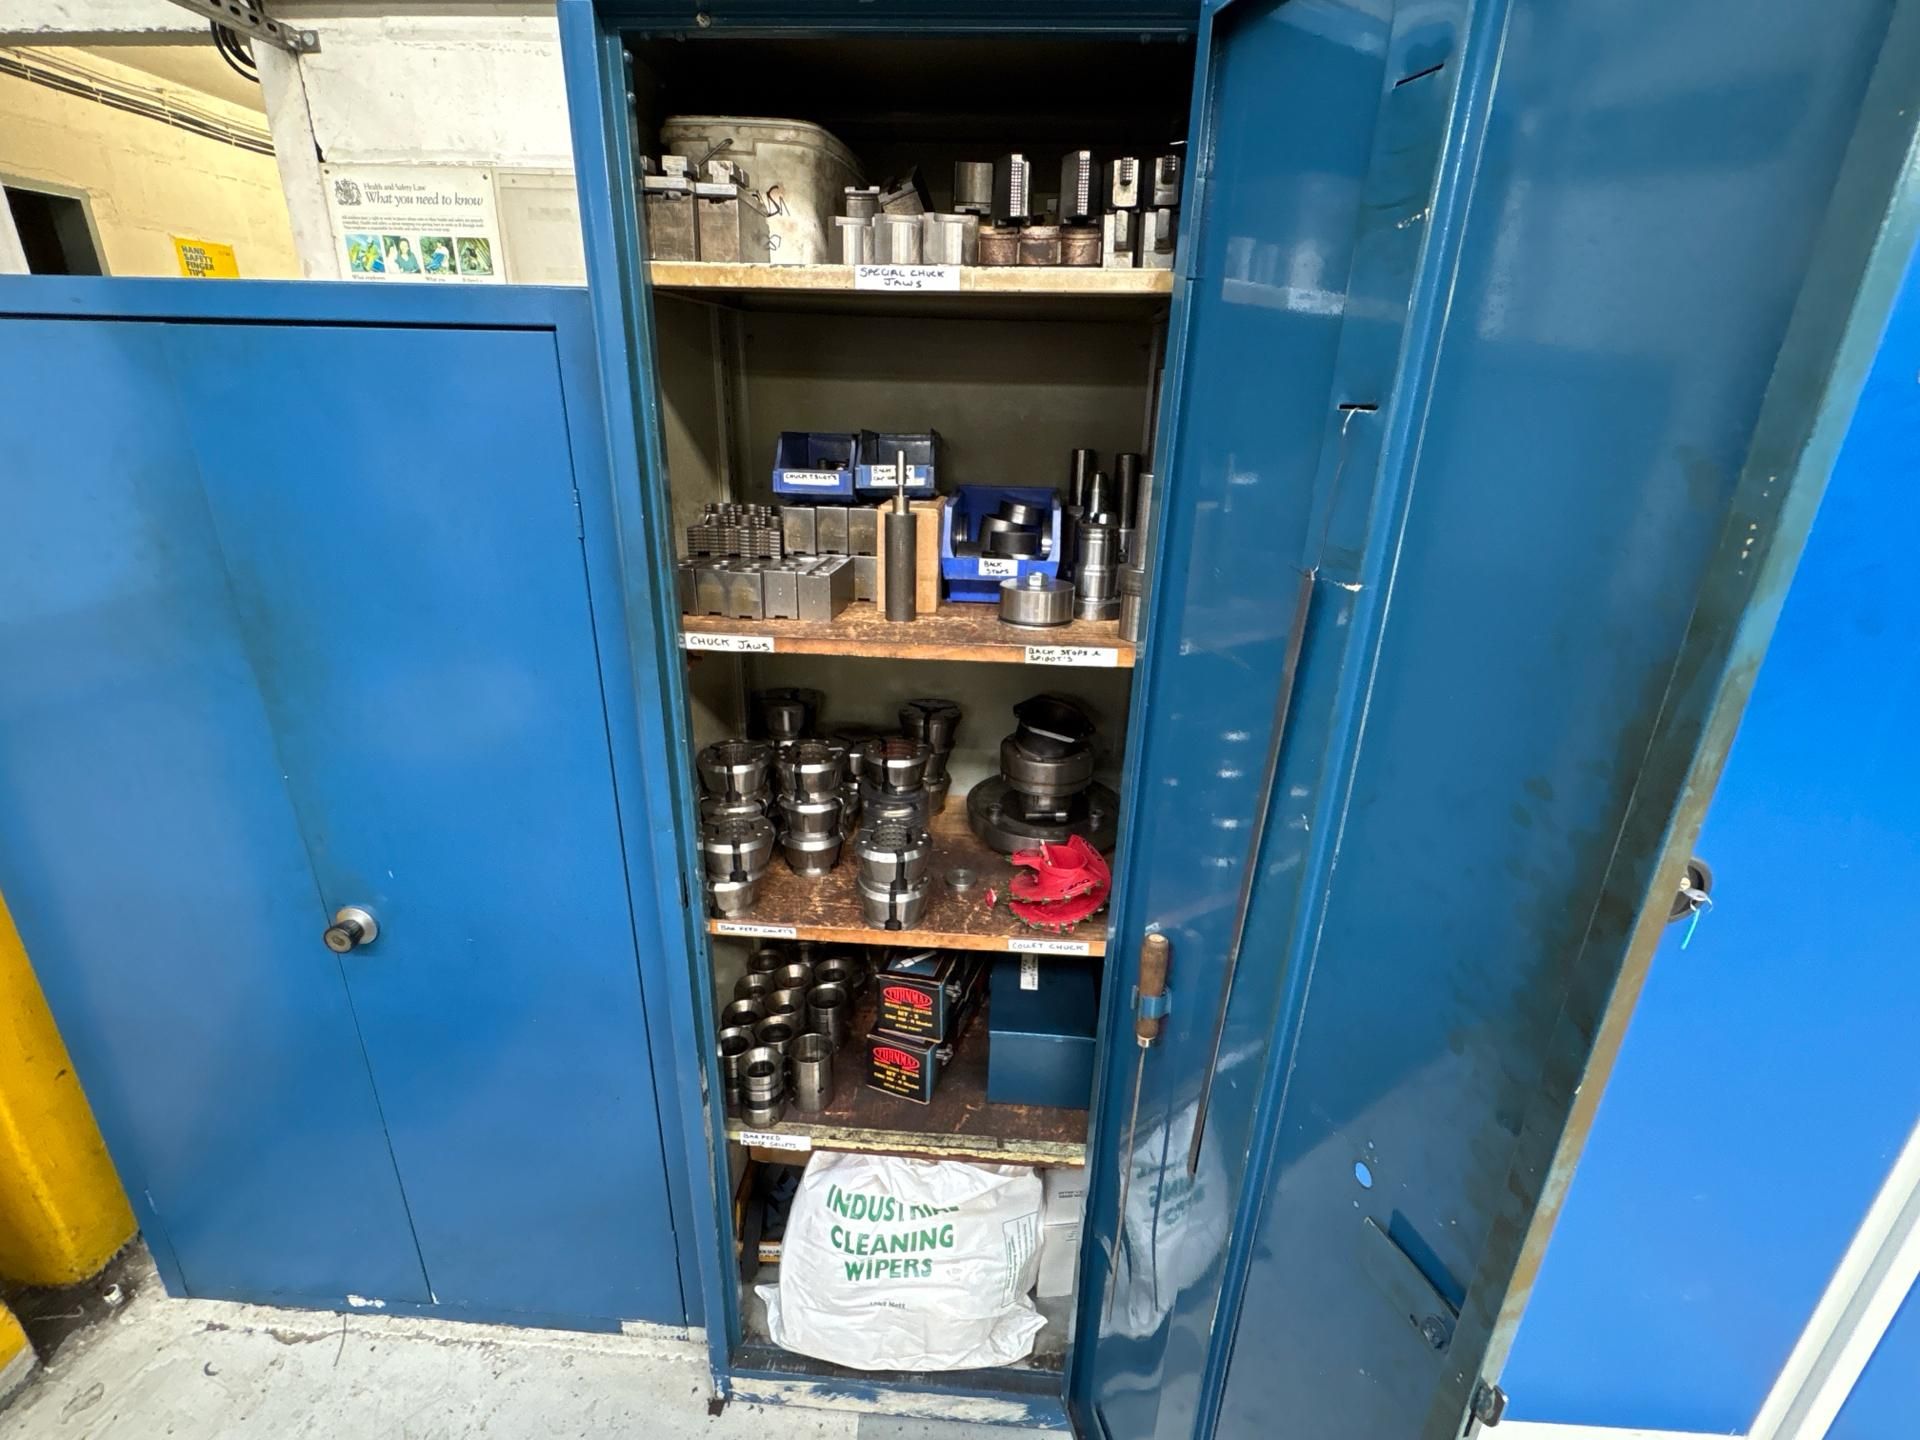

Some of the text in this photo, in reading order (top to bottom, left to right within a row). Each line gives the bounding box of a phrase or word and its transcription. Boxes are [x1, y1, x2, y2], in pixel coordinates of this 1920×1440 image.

[365, 191, 483, 207] What you need to know
[181, 245, 205, 255] HAND
[184, 253, 213, 264] SAFETY
[860, 267, 945, 278] SPECIAL CHUCK
[883, 277, 922, 288] JAWS
[690, 636, 730, 647] CHUCK
[737, 640, 770, 651] JAWS
[1048, 943, 1084, 951] CHUCK
[830, 1224, 954, 1256] CLEANING
[844, 1258, 933, 1281] WIPERS
